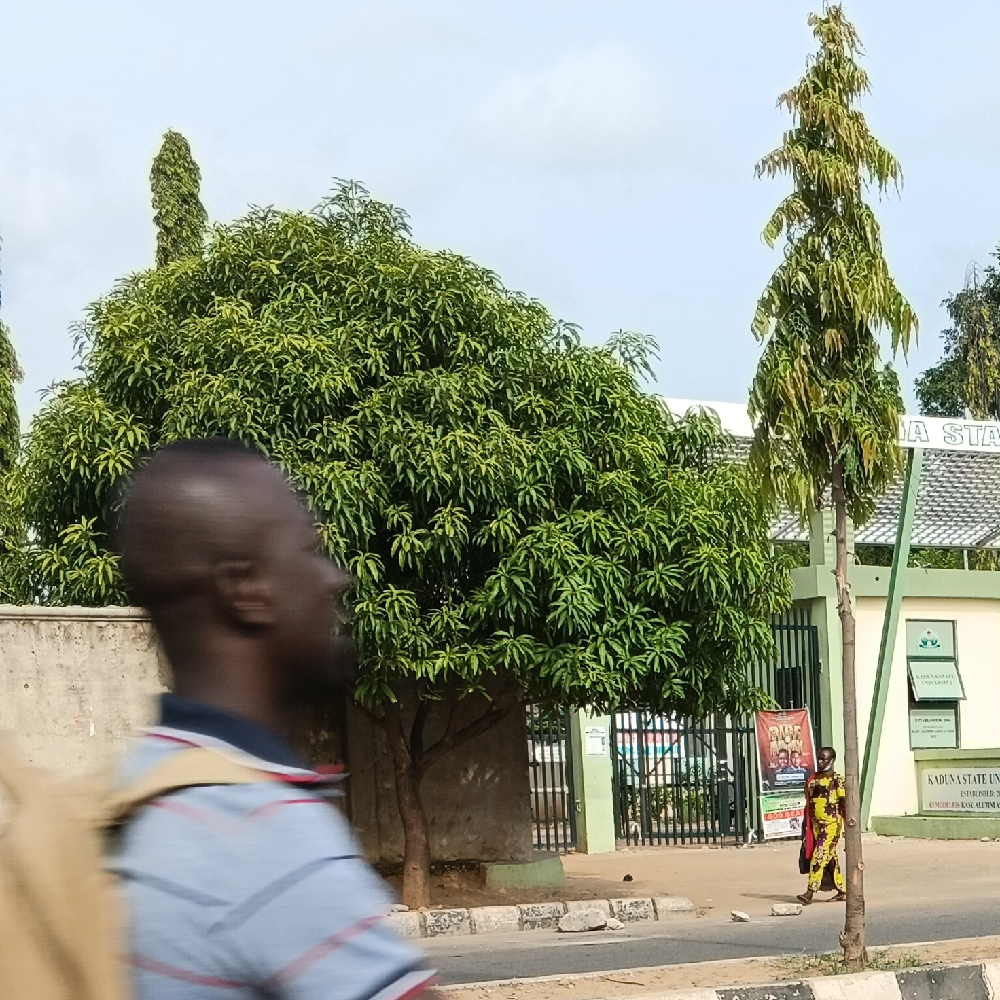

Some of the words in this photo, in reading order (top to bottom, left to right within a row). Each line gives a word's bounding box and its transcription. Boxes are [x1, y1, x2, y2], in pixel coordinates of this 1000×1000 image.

[899, 420, 929, 442] A
[927, 773, 962, 785] KADUNA
[962, 773, 987, 785] STATE
[960, 801, 974, 809] KASU
[975, 801, 996, 809] ALUMNI
